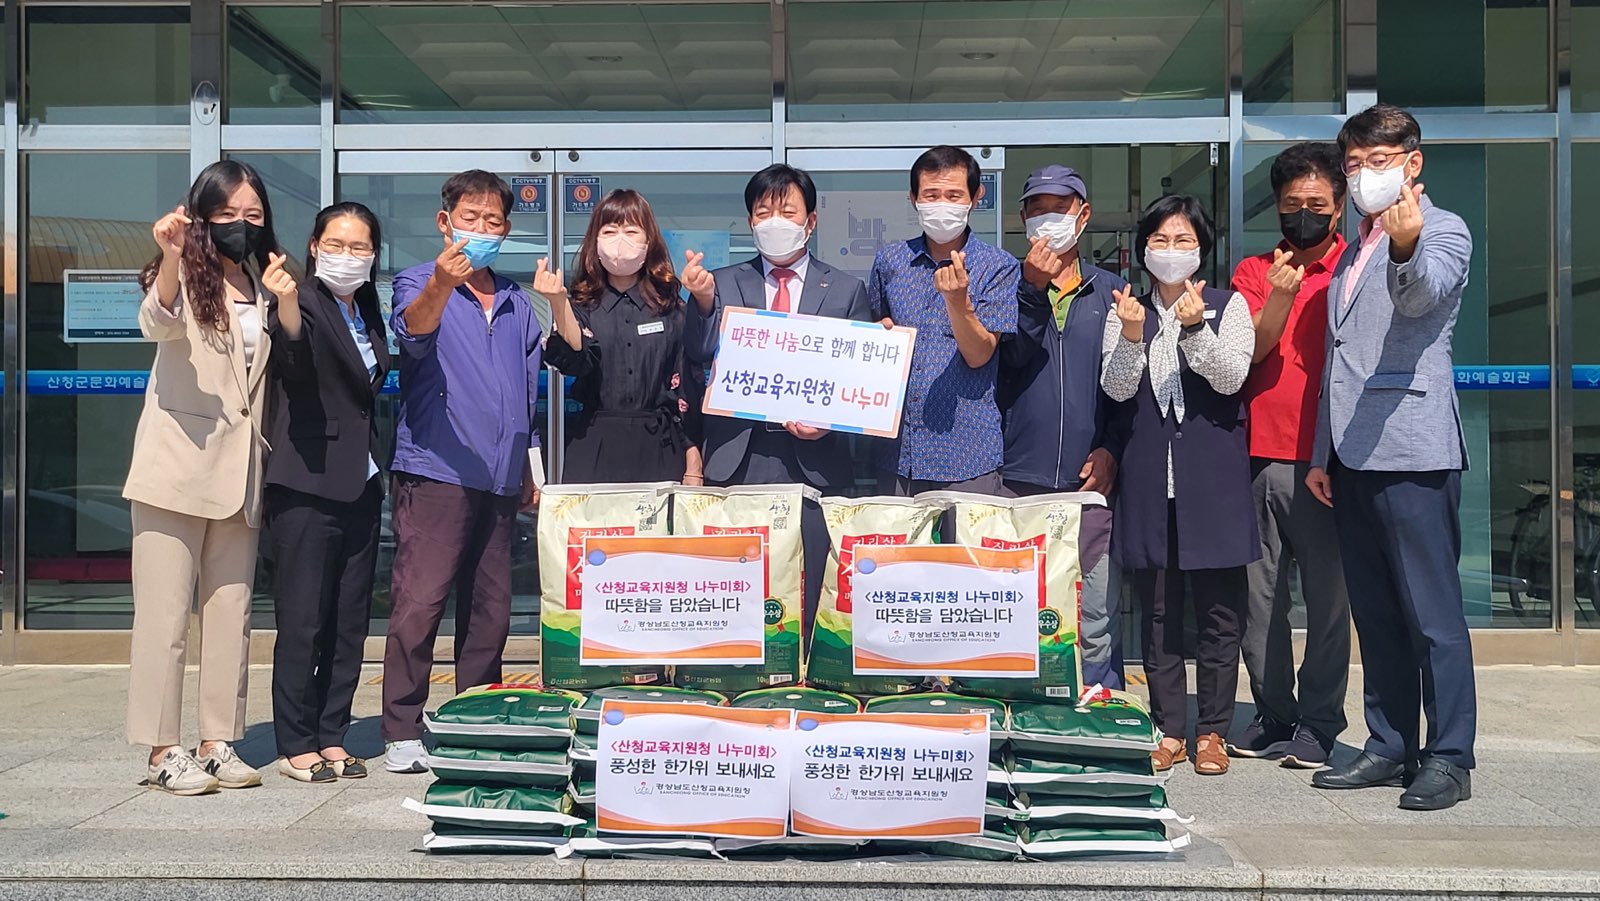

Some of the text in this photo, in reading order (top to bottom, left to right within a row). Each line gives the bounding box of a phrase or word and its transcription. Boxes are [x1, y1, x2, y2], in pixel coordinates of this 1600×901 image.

[731, 326, 900, 365] 따뜻한 나눔으로 함께 합니다
[47, 376, 146, 389] 산청군문화예술
[1457, 371, 1531, 385] 화예술회관
[721, 369, 891, 411] 산청교육지원청 나누미
[594, 581, 689, 594] <산청교육지원청
[694, 580, 753, 594] 나누미회>
[605, 597, 741, 614] 따뜻함을 담았습니다
[864, 590, 1025, 604] <산청교육지원청 나누미회>
[875, 608, 1013, 624] 따뜻함을 담았습니다
[610, 740, 777, 759] <산청교육지원청 나누미회>
[804, 744, 975, 763] <산청교육지원청 나누미회>
[609, 758, 776, 780] 풍성한 한가위 보내세요
[804, 762, 973, 783] 풍성한 한가위 보내세요
